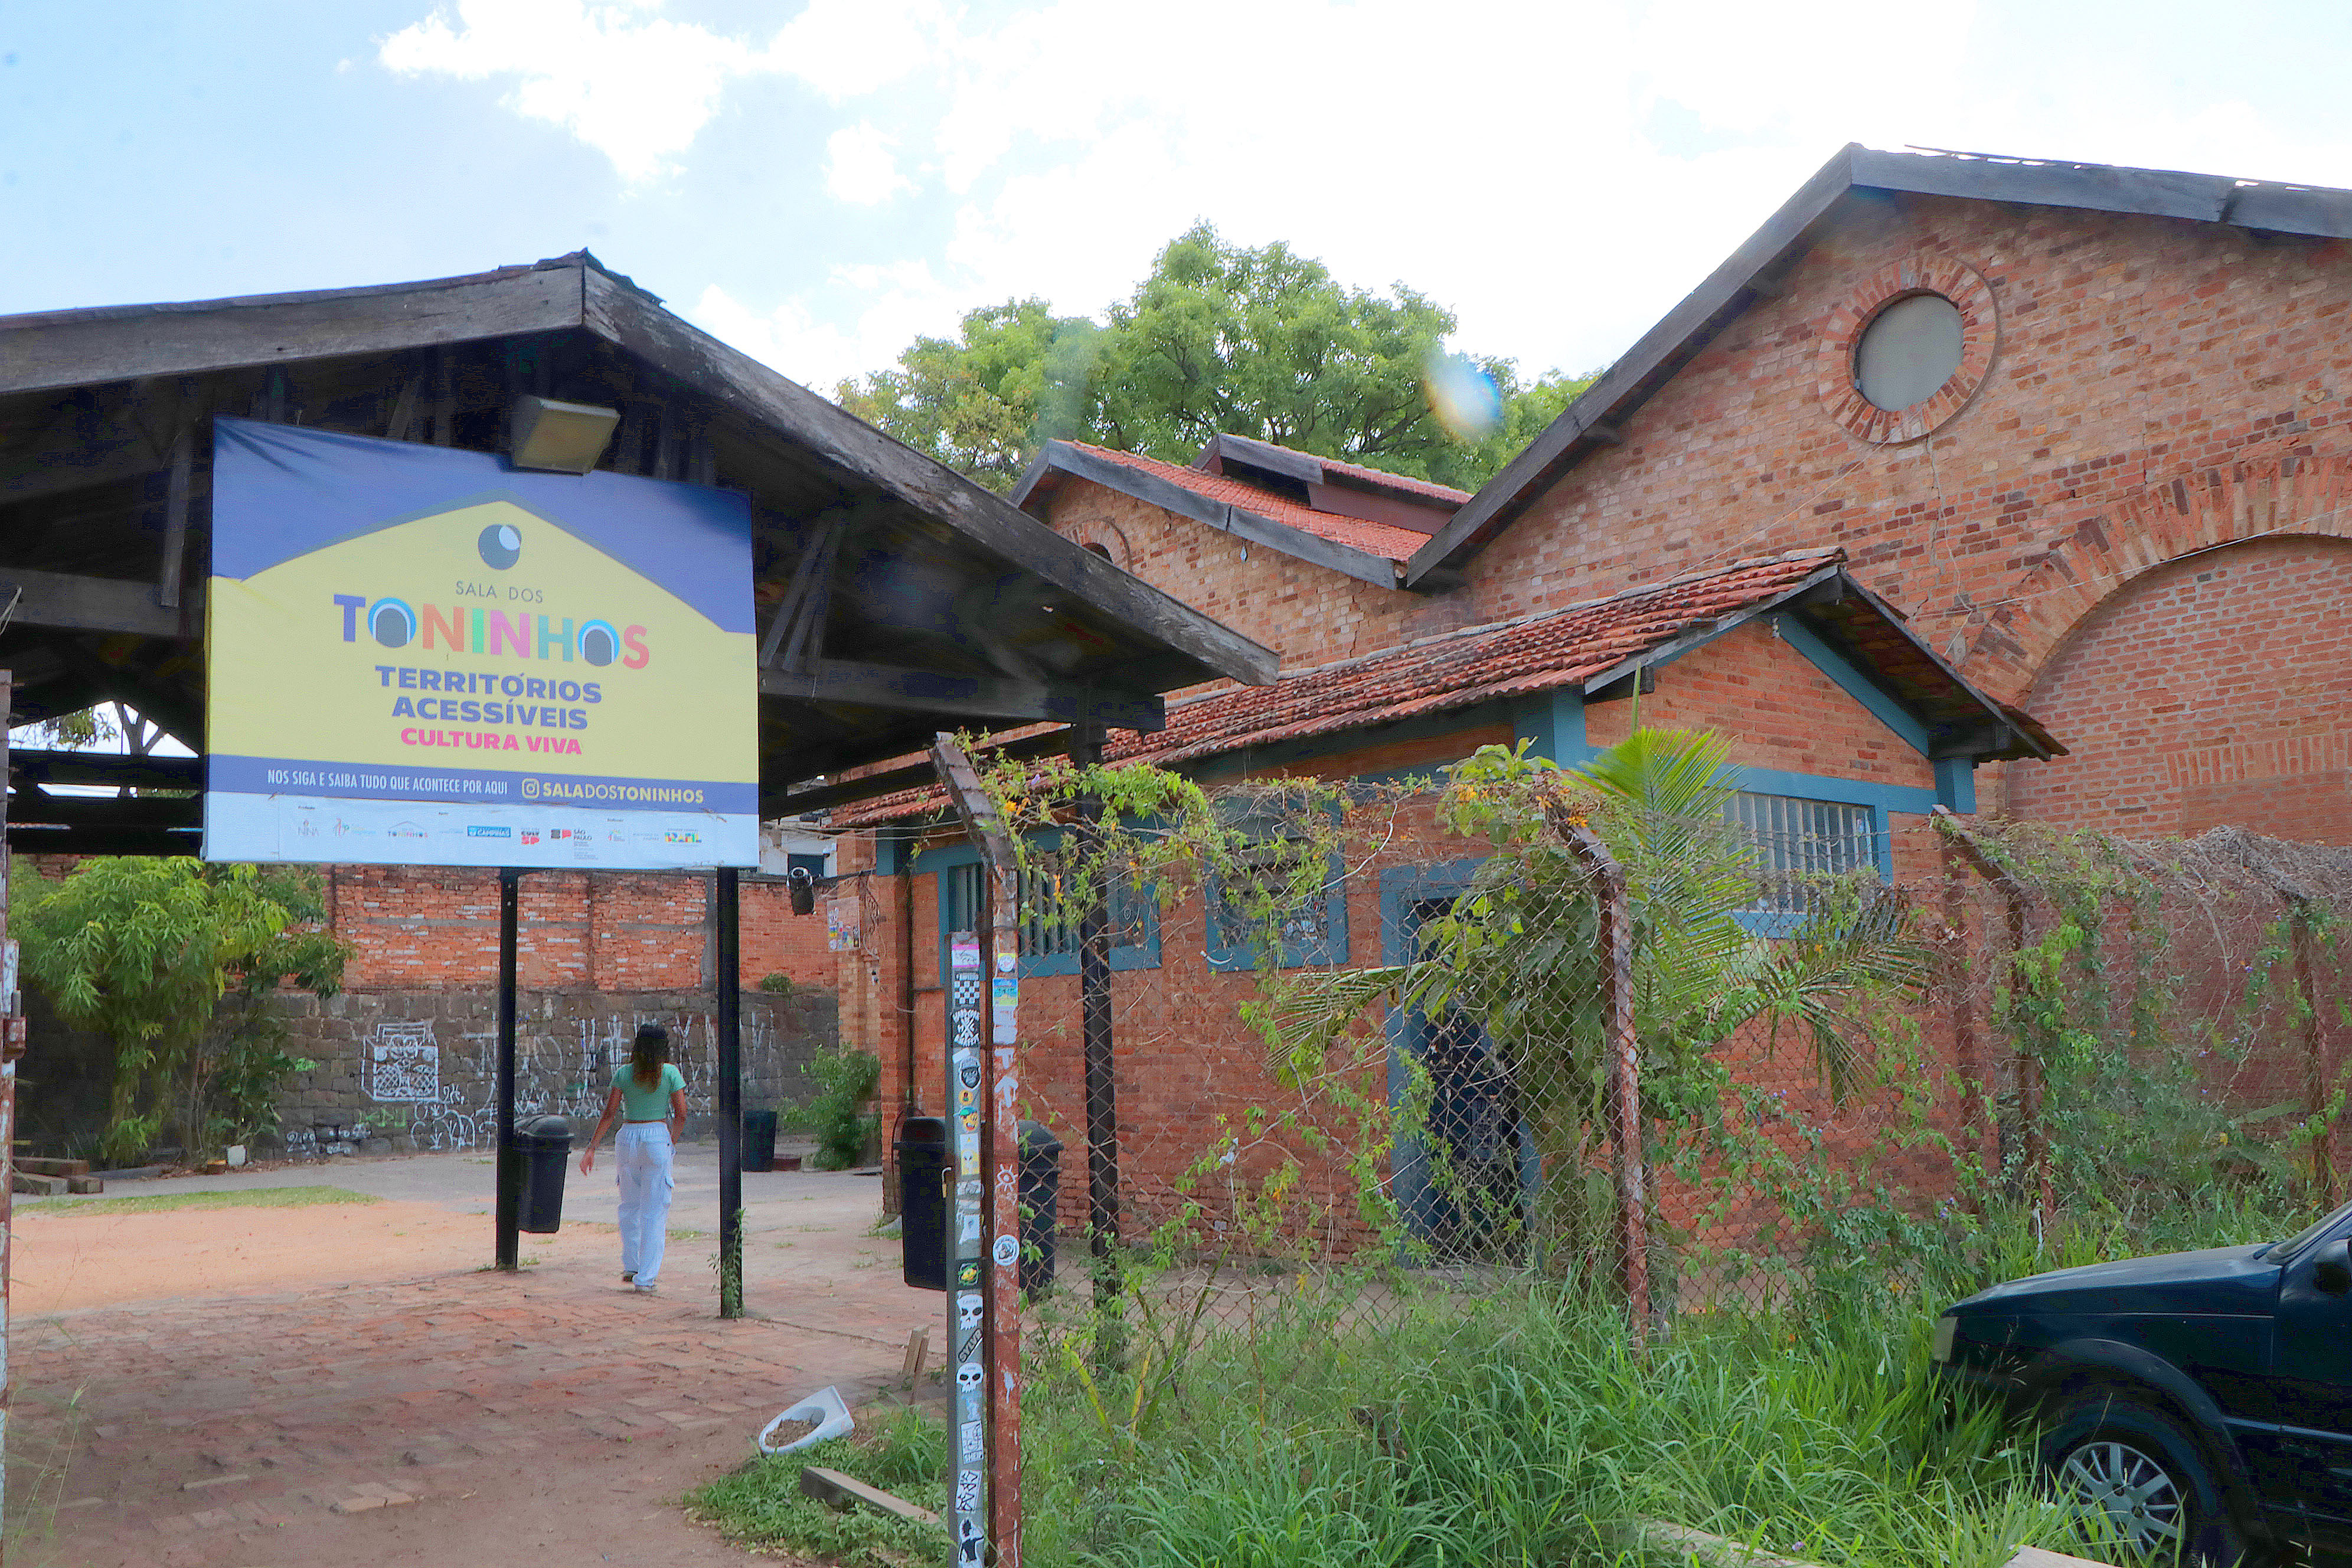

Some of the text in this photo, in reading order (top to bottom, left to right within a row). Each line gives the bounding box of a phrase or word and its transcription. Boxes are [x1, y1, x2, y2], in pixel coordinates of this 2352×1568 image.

[455, 580, 544, 603] SALA DOS
[334, 593, 651, 669] TONINHOS
[375, 665, 603, 704] TERRITÓRIOS
[391, 696, 589, 730] ACESSÍVEIS
[400, 727, 582, 756] CULTURA VIVA
[267, 769, 508, 795] NOS SIGA E SAIBA TUDO QUE ACONTECE POR AQUI
[543, 782, 704, 804] SALADOSTONINHOS
